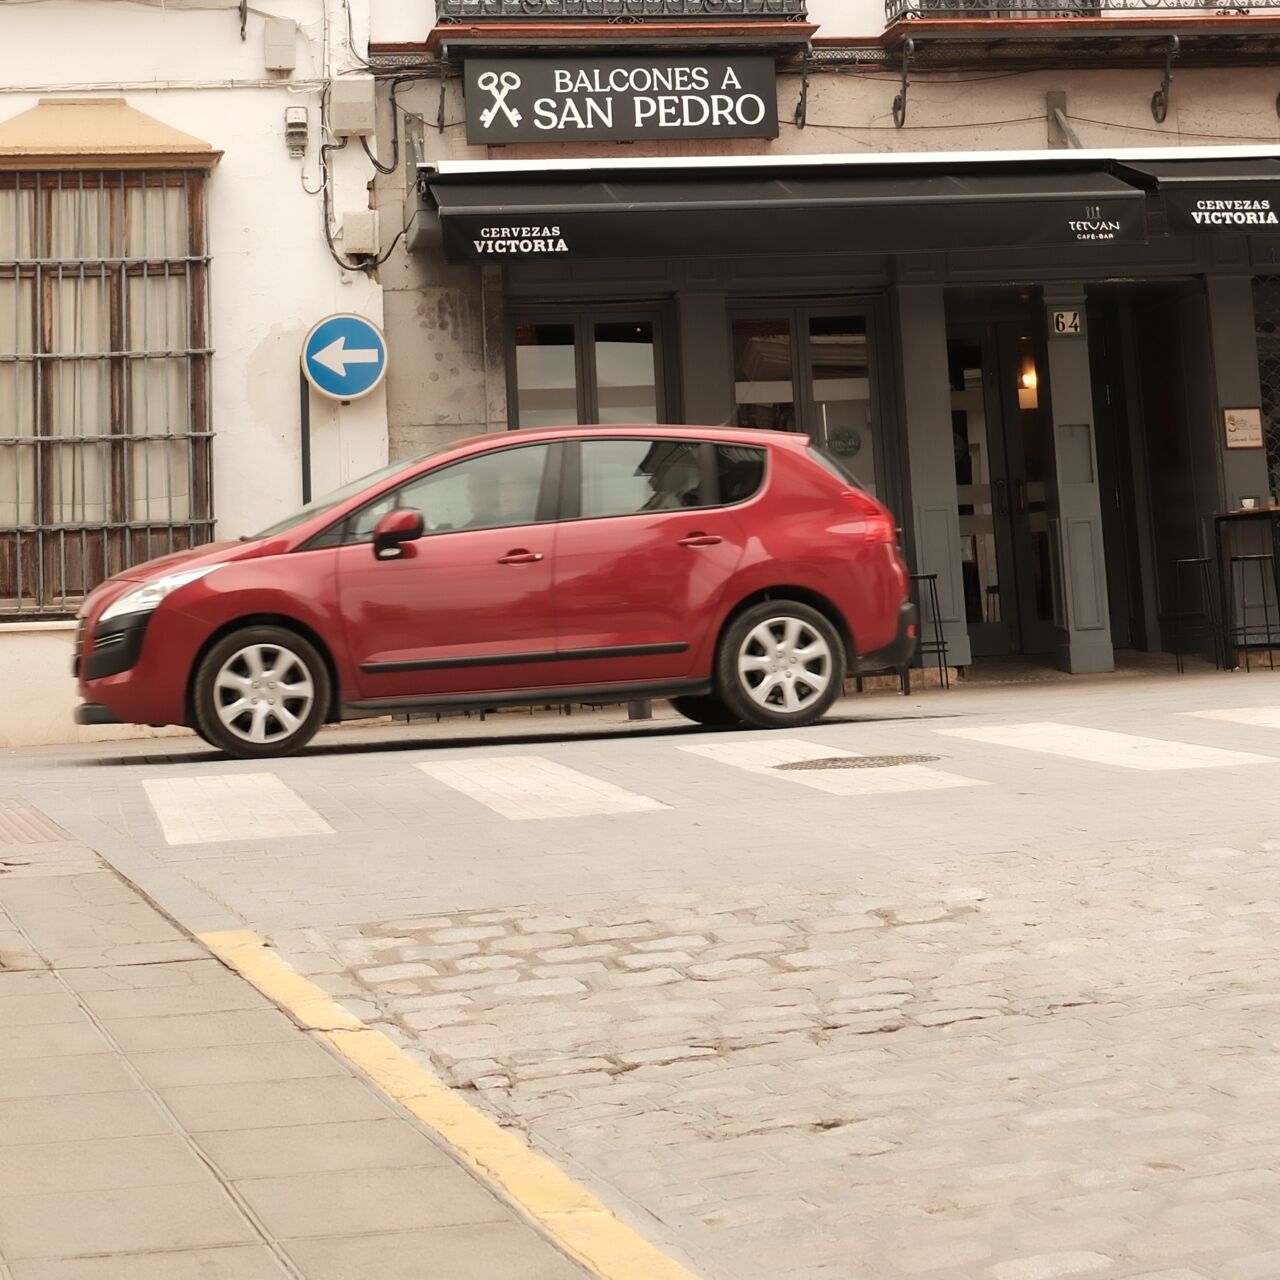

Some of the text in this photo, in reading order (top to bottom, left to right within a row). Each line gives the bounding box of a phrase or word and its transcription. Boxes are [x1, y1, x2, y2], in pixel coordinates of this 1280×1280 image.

[554, 66, 742, 93] BALCONES A
[533, 94, 766, 130] SAN PEDRO
[1196, 199, 1270, 210] CERVEZAS
[1191, 211, 1279, 224] VICTORIA
[480, 226, 561, 238] CERVEZAS
[1068, 221, 1120, 231] TETUAN
[473, 238, 569, 253] VICTORIA
[1055, 312, 1080, 332] 64
